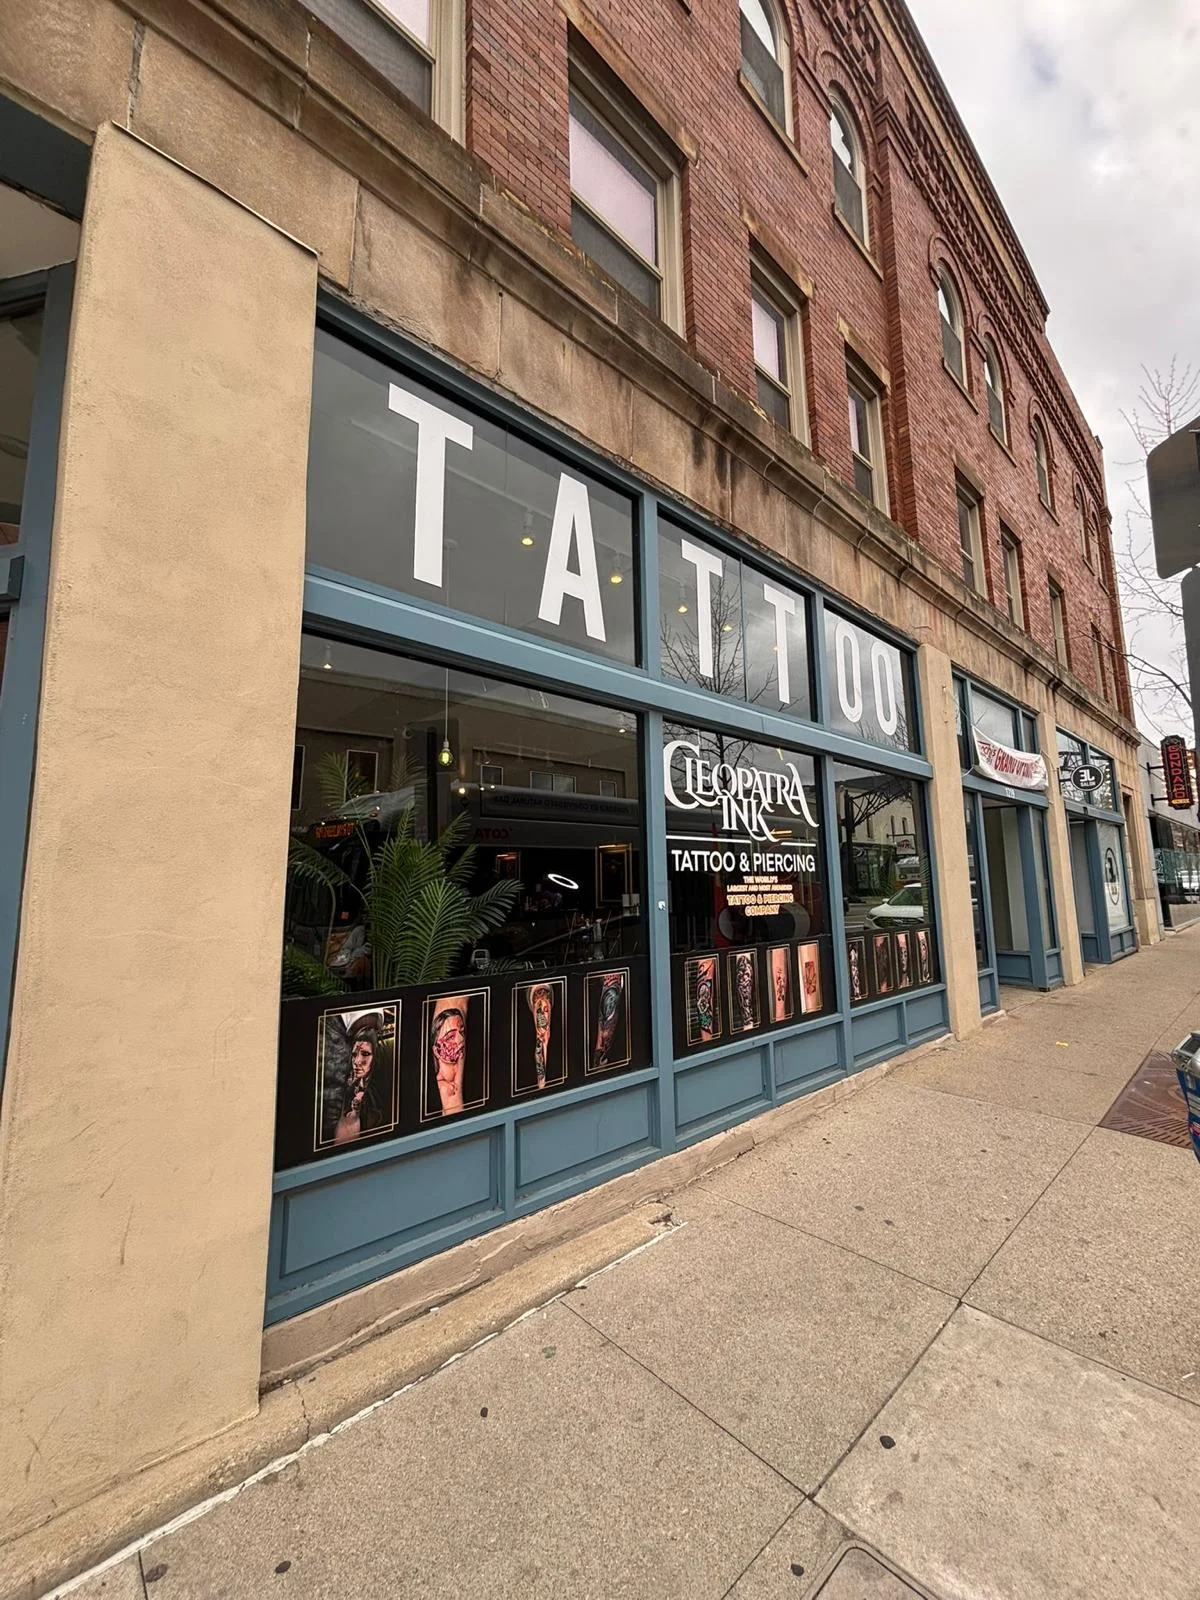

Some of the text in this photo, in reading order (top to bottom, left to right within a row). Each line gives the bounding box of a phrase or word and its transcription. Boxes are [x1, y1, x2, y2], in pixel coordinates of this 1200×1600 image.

[387, 382, 901, 737] TATTOO
[663, 739, 820, 828] CLEOPATRA
[717, 789, 781, 843] INK
[671, 849, 816, 872] TATTOO & PIERCING
[726, 894, 756, 906] TATTOO
[763, 893, 794, 904] PIERCING
[745, 905, 780, 917] COMPANY
